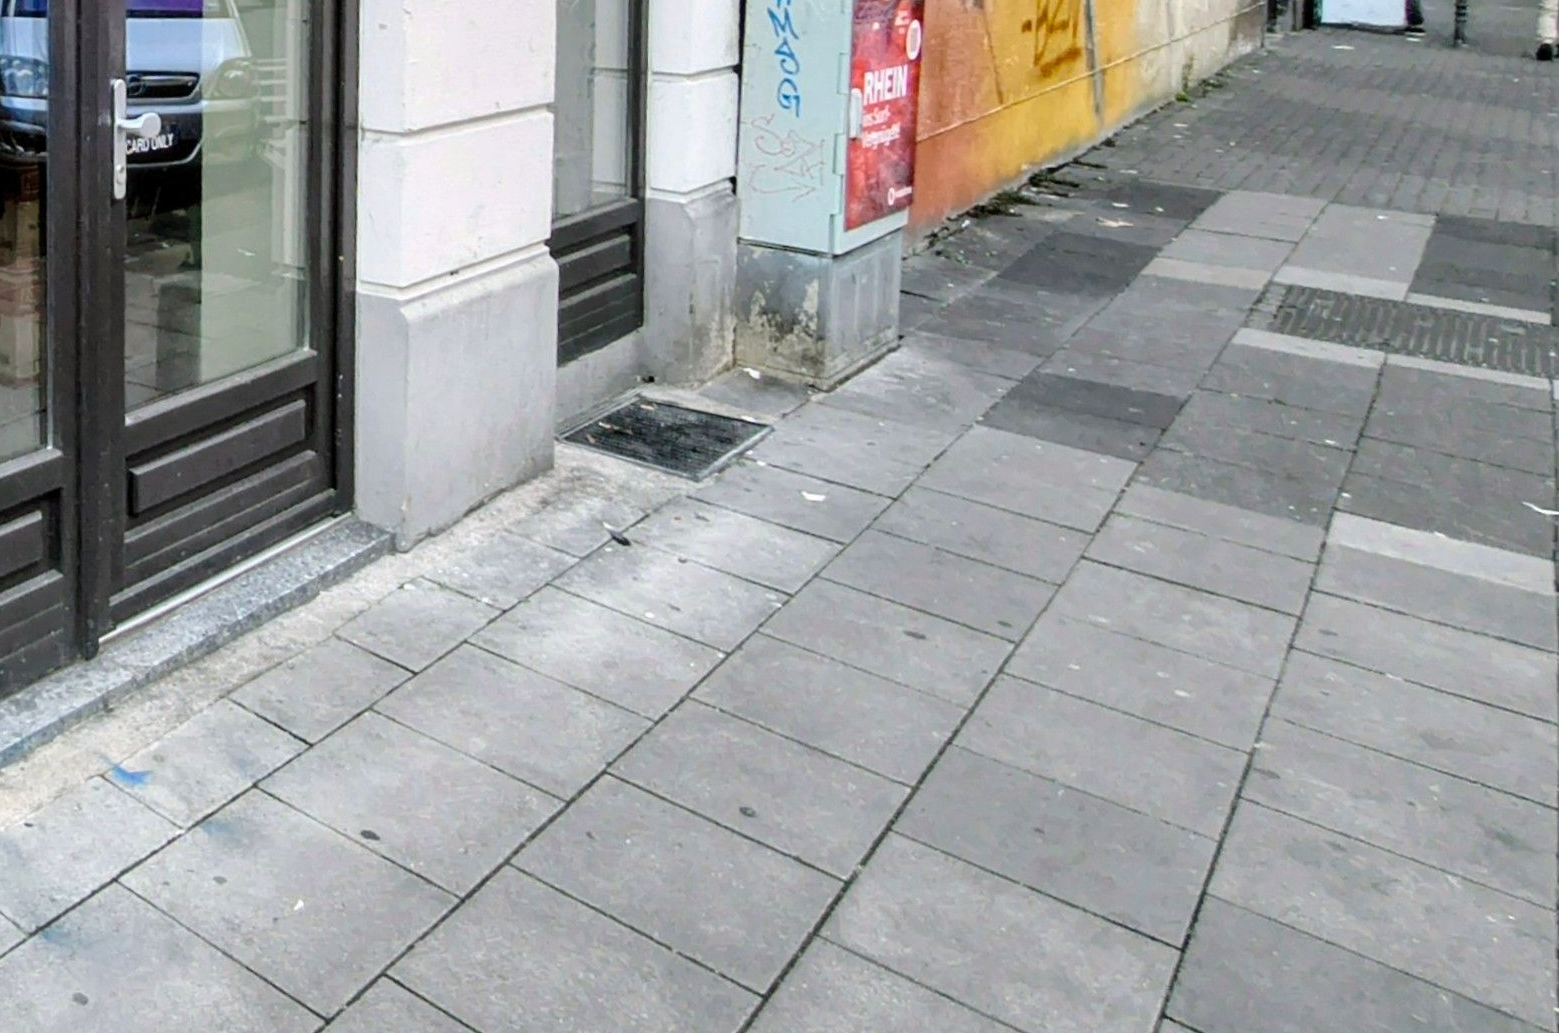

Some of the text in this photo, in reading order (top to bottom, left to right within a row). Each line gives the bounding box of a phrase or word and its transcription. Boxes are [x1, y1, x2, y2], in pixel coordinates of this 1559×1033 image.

[863, 64, 908, 106] RHEIN
[126, 133, 174, 155] CARD ONLY
